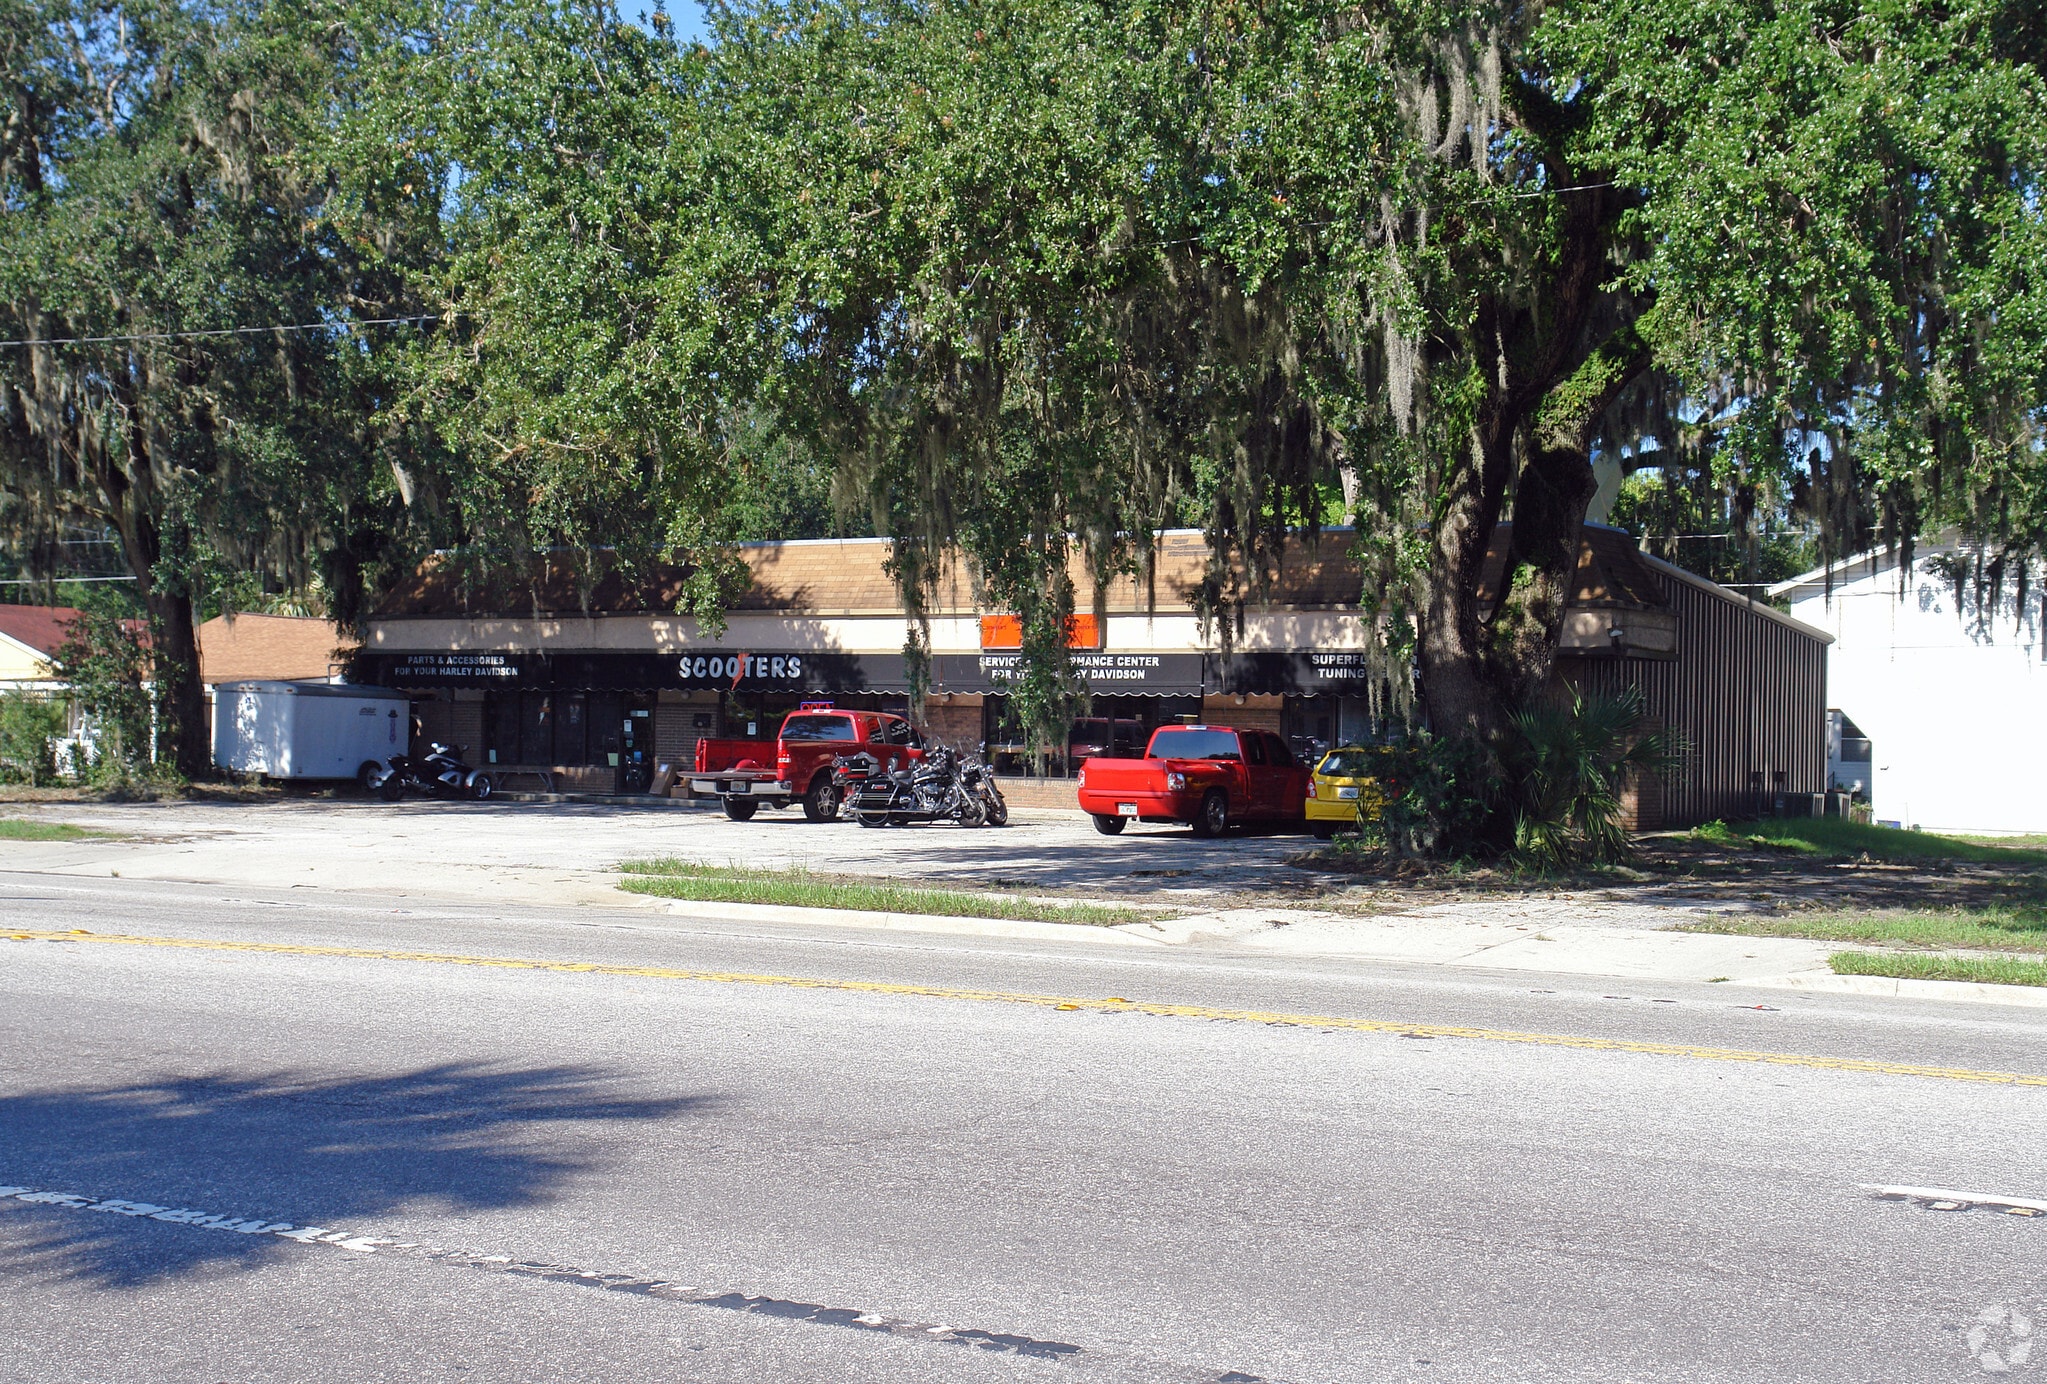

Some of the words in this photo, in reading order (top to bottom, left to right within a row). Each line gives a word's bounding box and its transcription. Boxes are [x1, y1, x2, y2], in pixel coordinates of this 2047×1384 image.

[407, 656, 435, 665] PARTS
[437, 656, 444, 665] &
[446, 656, 505, 665] ACCESSORIES
[1117, 656, 1160, 667] CENTER
[1312, 655, 1386, 665] SUPERFL
[394, 667, 411, 676] FOR
[414, 667, 437, 676] YOUR
[440, 667, 472, 676] HARLEY
[475, 667, 519, 676] DAVIDSON
[679, 654, 801, 679] SCOOTER'S
[1091, 669, 1146, 680] DAVIDSON
[1318, 668, 1366, 679] TUNING
